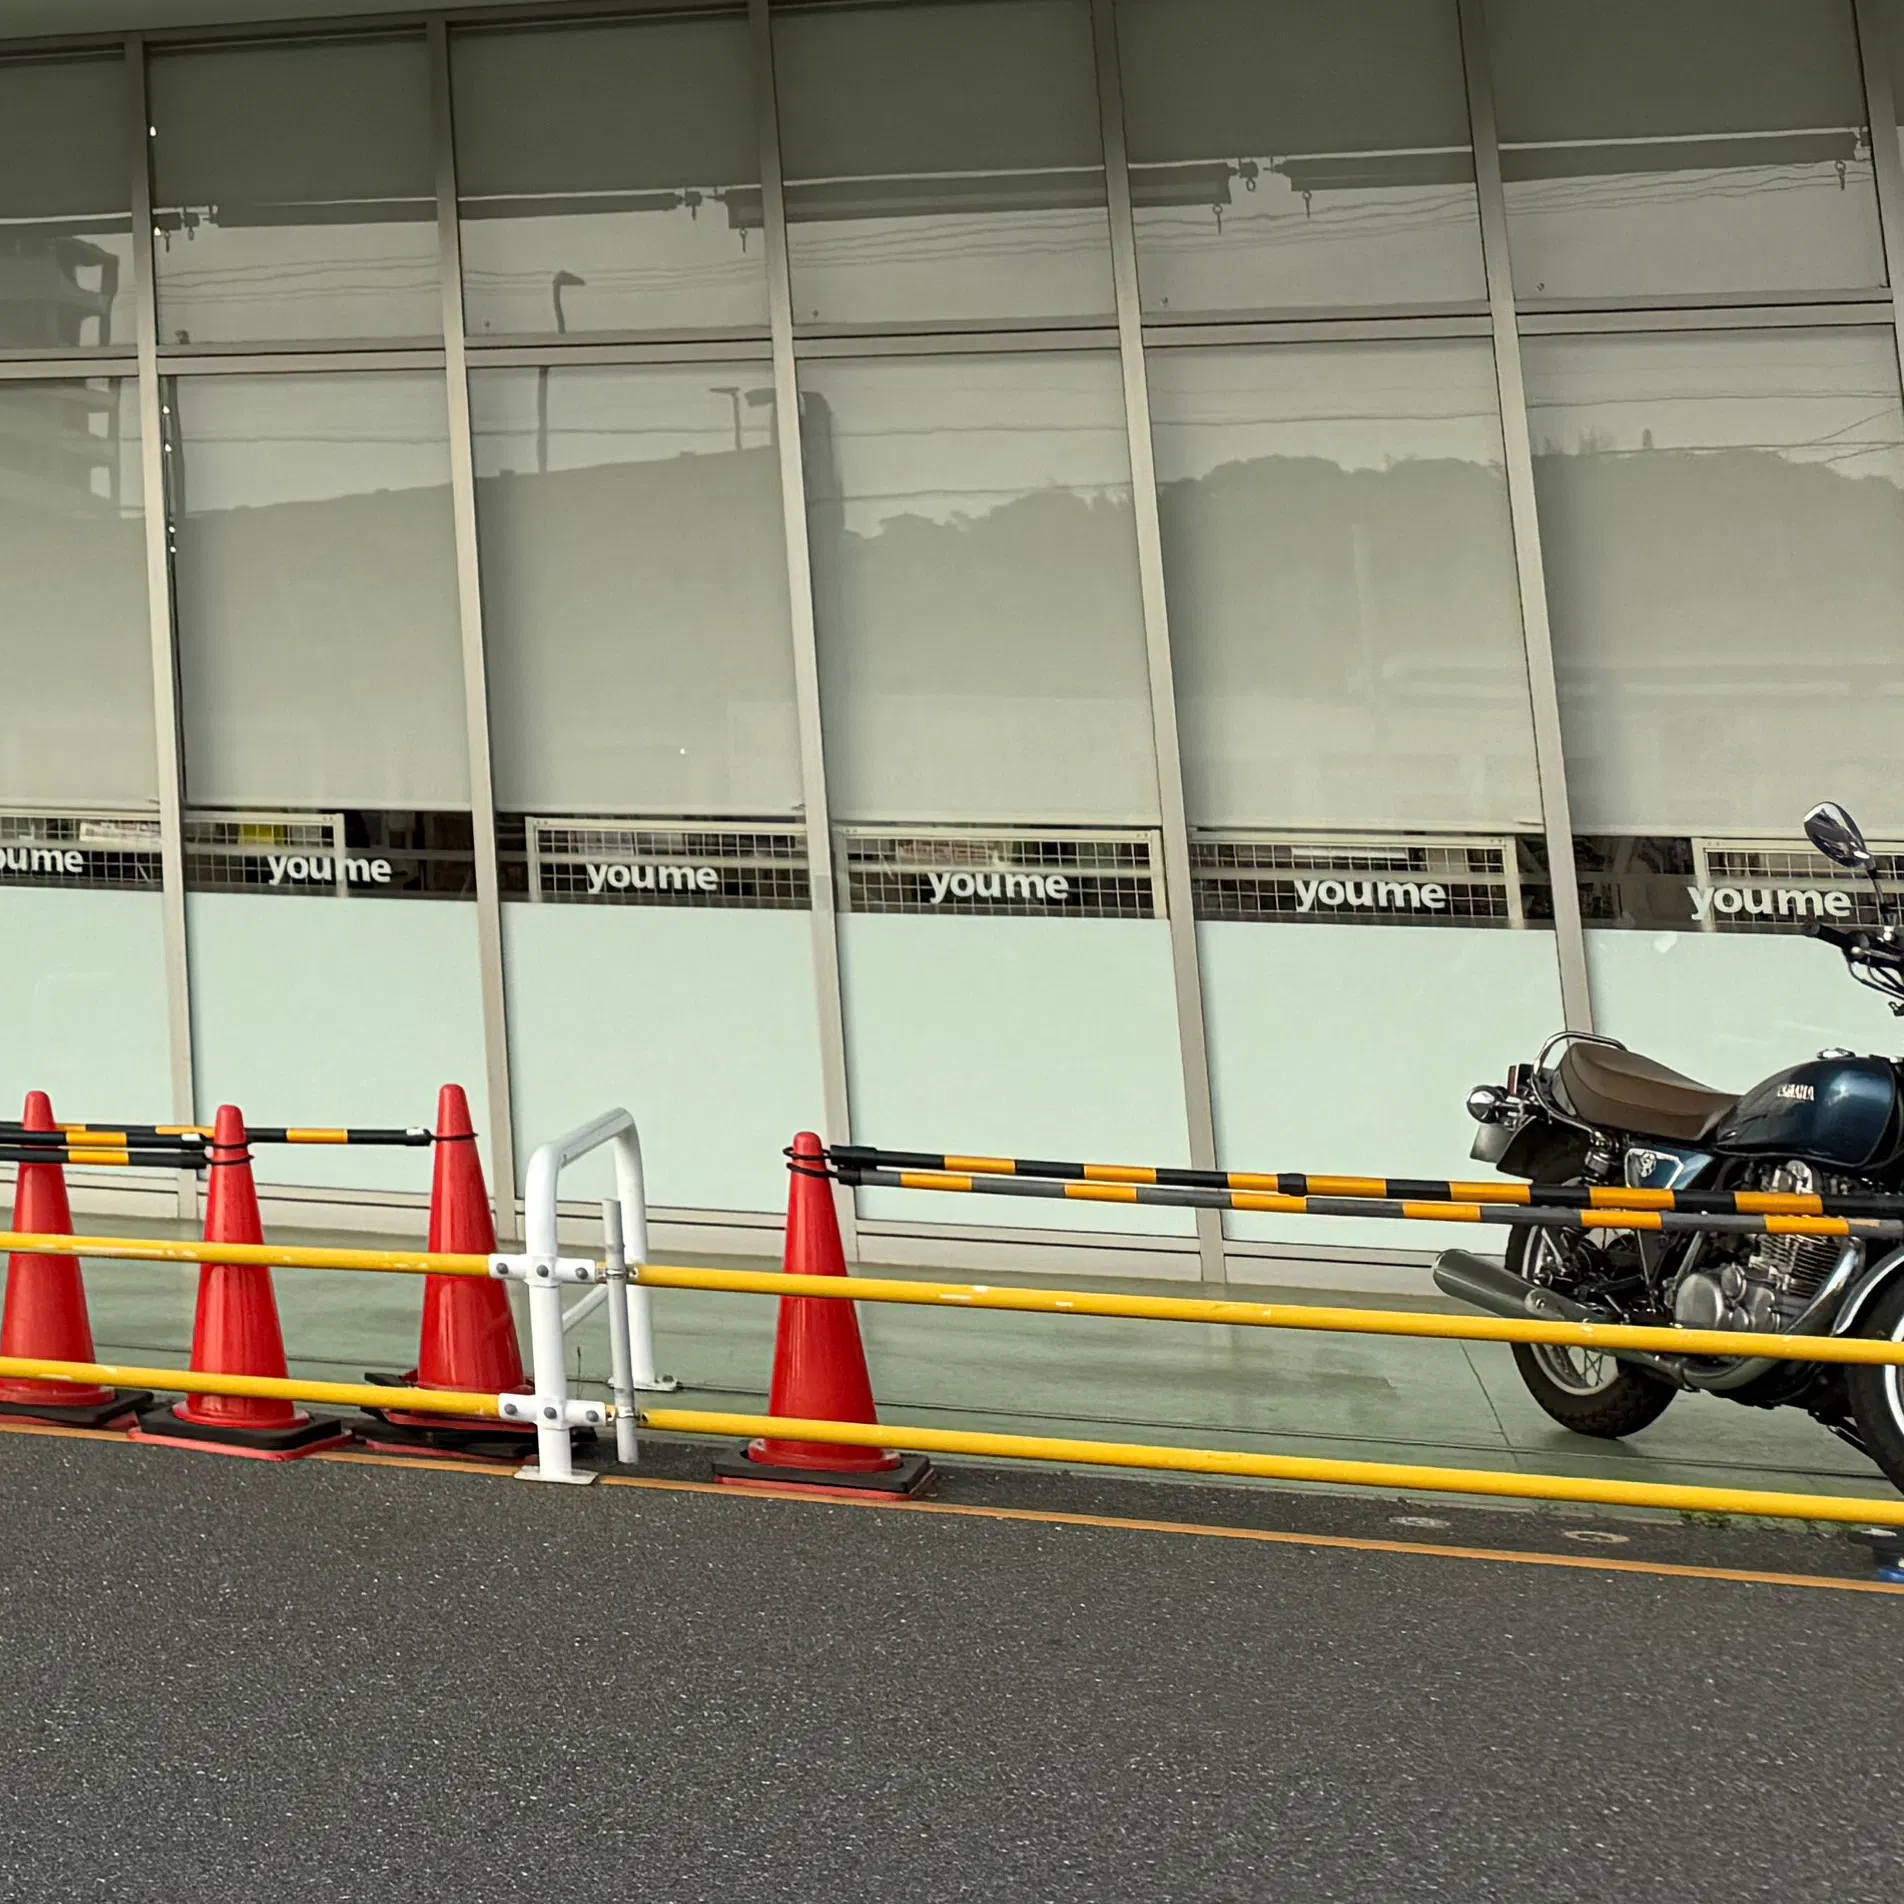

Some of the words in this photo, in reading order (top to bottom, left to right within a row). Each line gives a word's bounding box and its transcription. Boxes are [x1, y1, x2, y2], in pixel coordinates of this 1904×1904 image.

[268, 854, 392, 885] youme
[586, 862, 719, 895] youme
[927, 871, 1069, 904] youme
[1293, 879, 1447, 913] youme
[1687, 885, 1852, 920] youme
